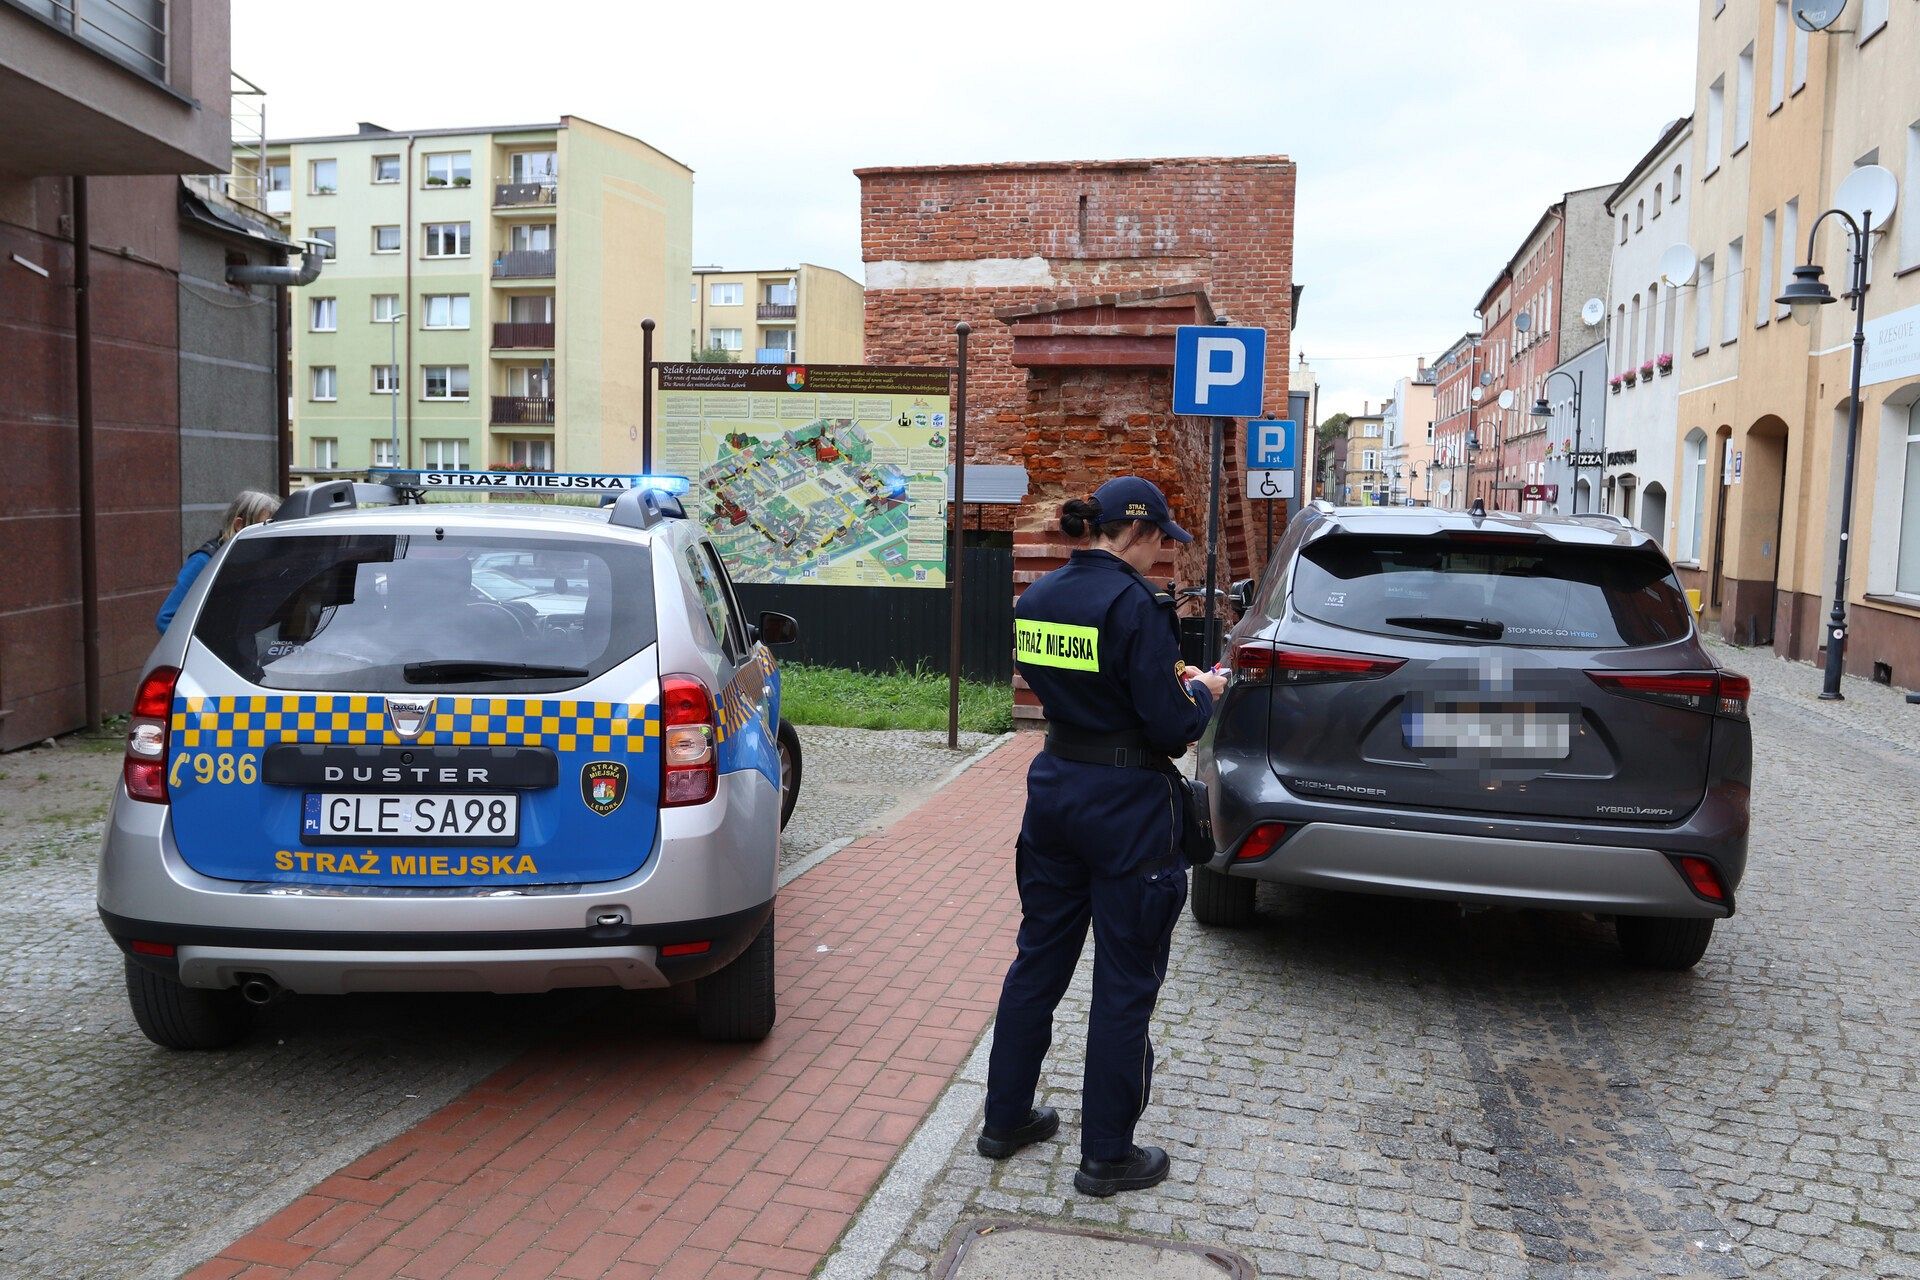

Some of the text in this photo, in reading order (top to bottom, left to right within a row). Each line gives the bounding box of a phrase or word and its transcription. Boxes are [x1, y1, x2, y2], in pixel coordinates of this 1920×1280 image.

[663, 364, 684, 375] Szlak
[1194, 336, 1246, 404] P
[1258, 425, 1286, 463] P
[514, 475, 624, 489] MIEJSKA
[1528, 627, 1553, 636] SMOG
[1570, 630, 1598, 638] HYBRID
[1018, 628, 1094, 660] STRAŻ MIEJSKA
[193, 753, 257, 784] 986
[324, 766, 489, 782] DUSTER
[589, 770, 620, 779] MIEJSKA
[1295, 780, 1387, 796] HIGHLANDER
[329, 798, 507, 833] GLE SA98
[1596, 806, 1634, 814] HYBRID
[306, 819, 319, 829] PL
[275, 850, 538, 876] STRAŻ MIEJSKA
